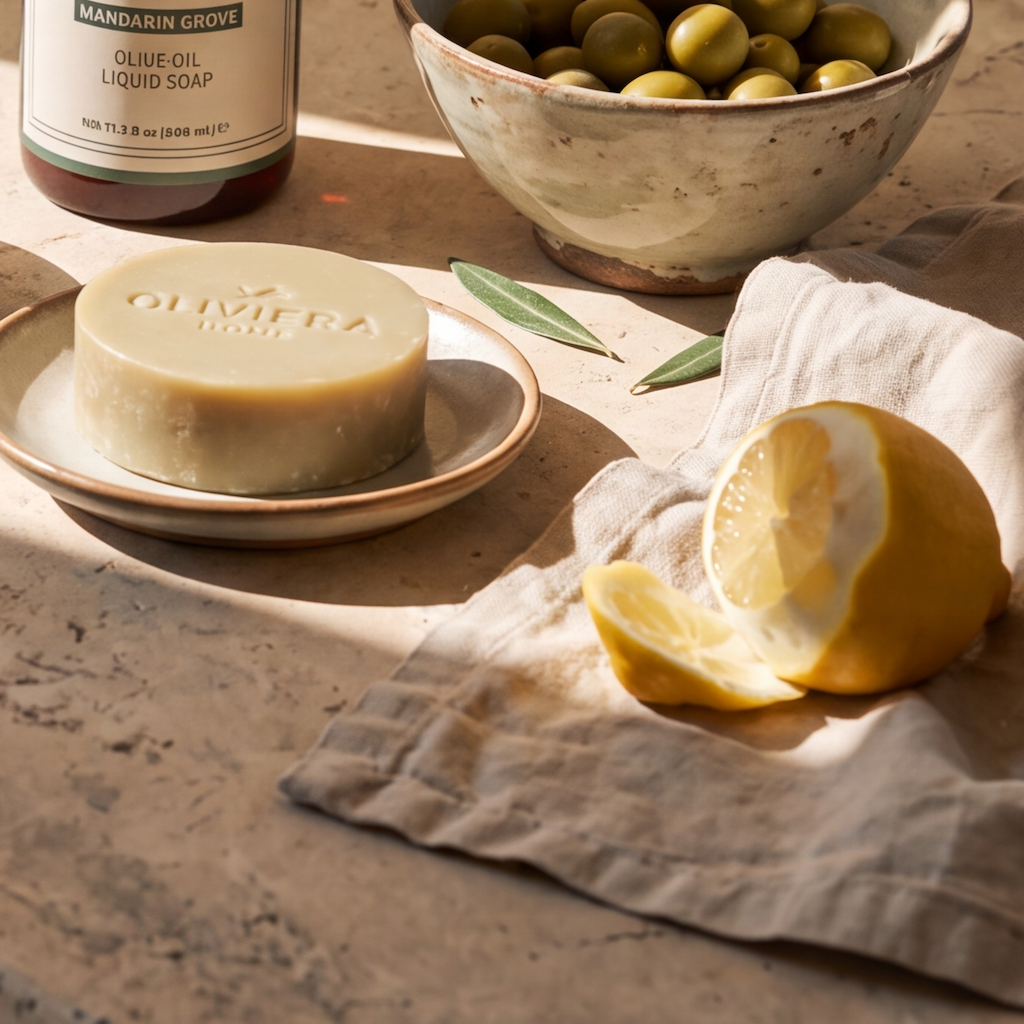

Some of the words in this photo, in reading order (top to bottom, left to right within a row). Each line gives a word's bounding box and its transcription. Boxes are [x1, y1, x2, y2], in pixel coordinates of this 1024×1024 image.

[79, 3, 175, 30] MANDARIN
[180, 9, 239, 30] GROVE
[102, 69, 161, 90] LIQUID
[166, 72, 214, 90] SOAP
[126, 290, 380, 339] OLIVIERA
